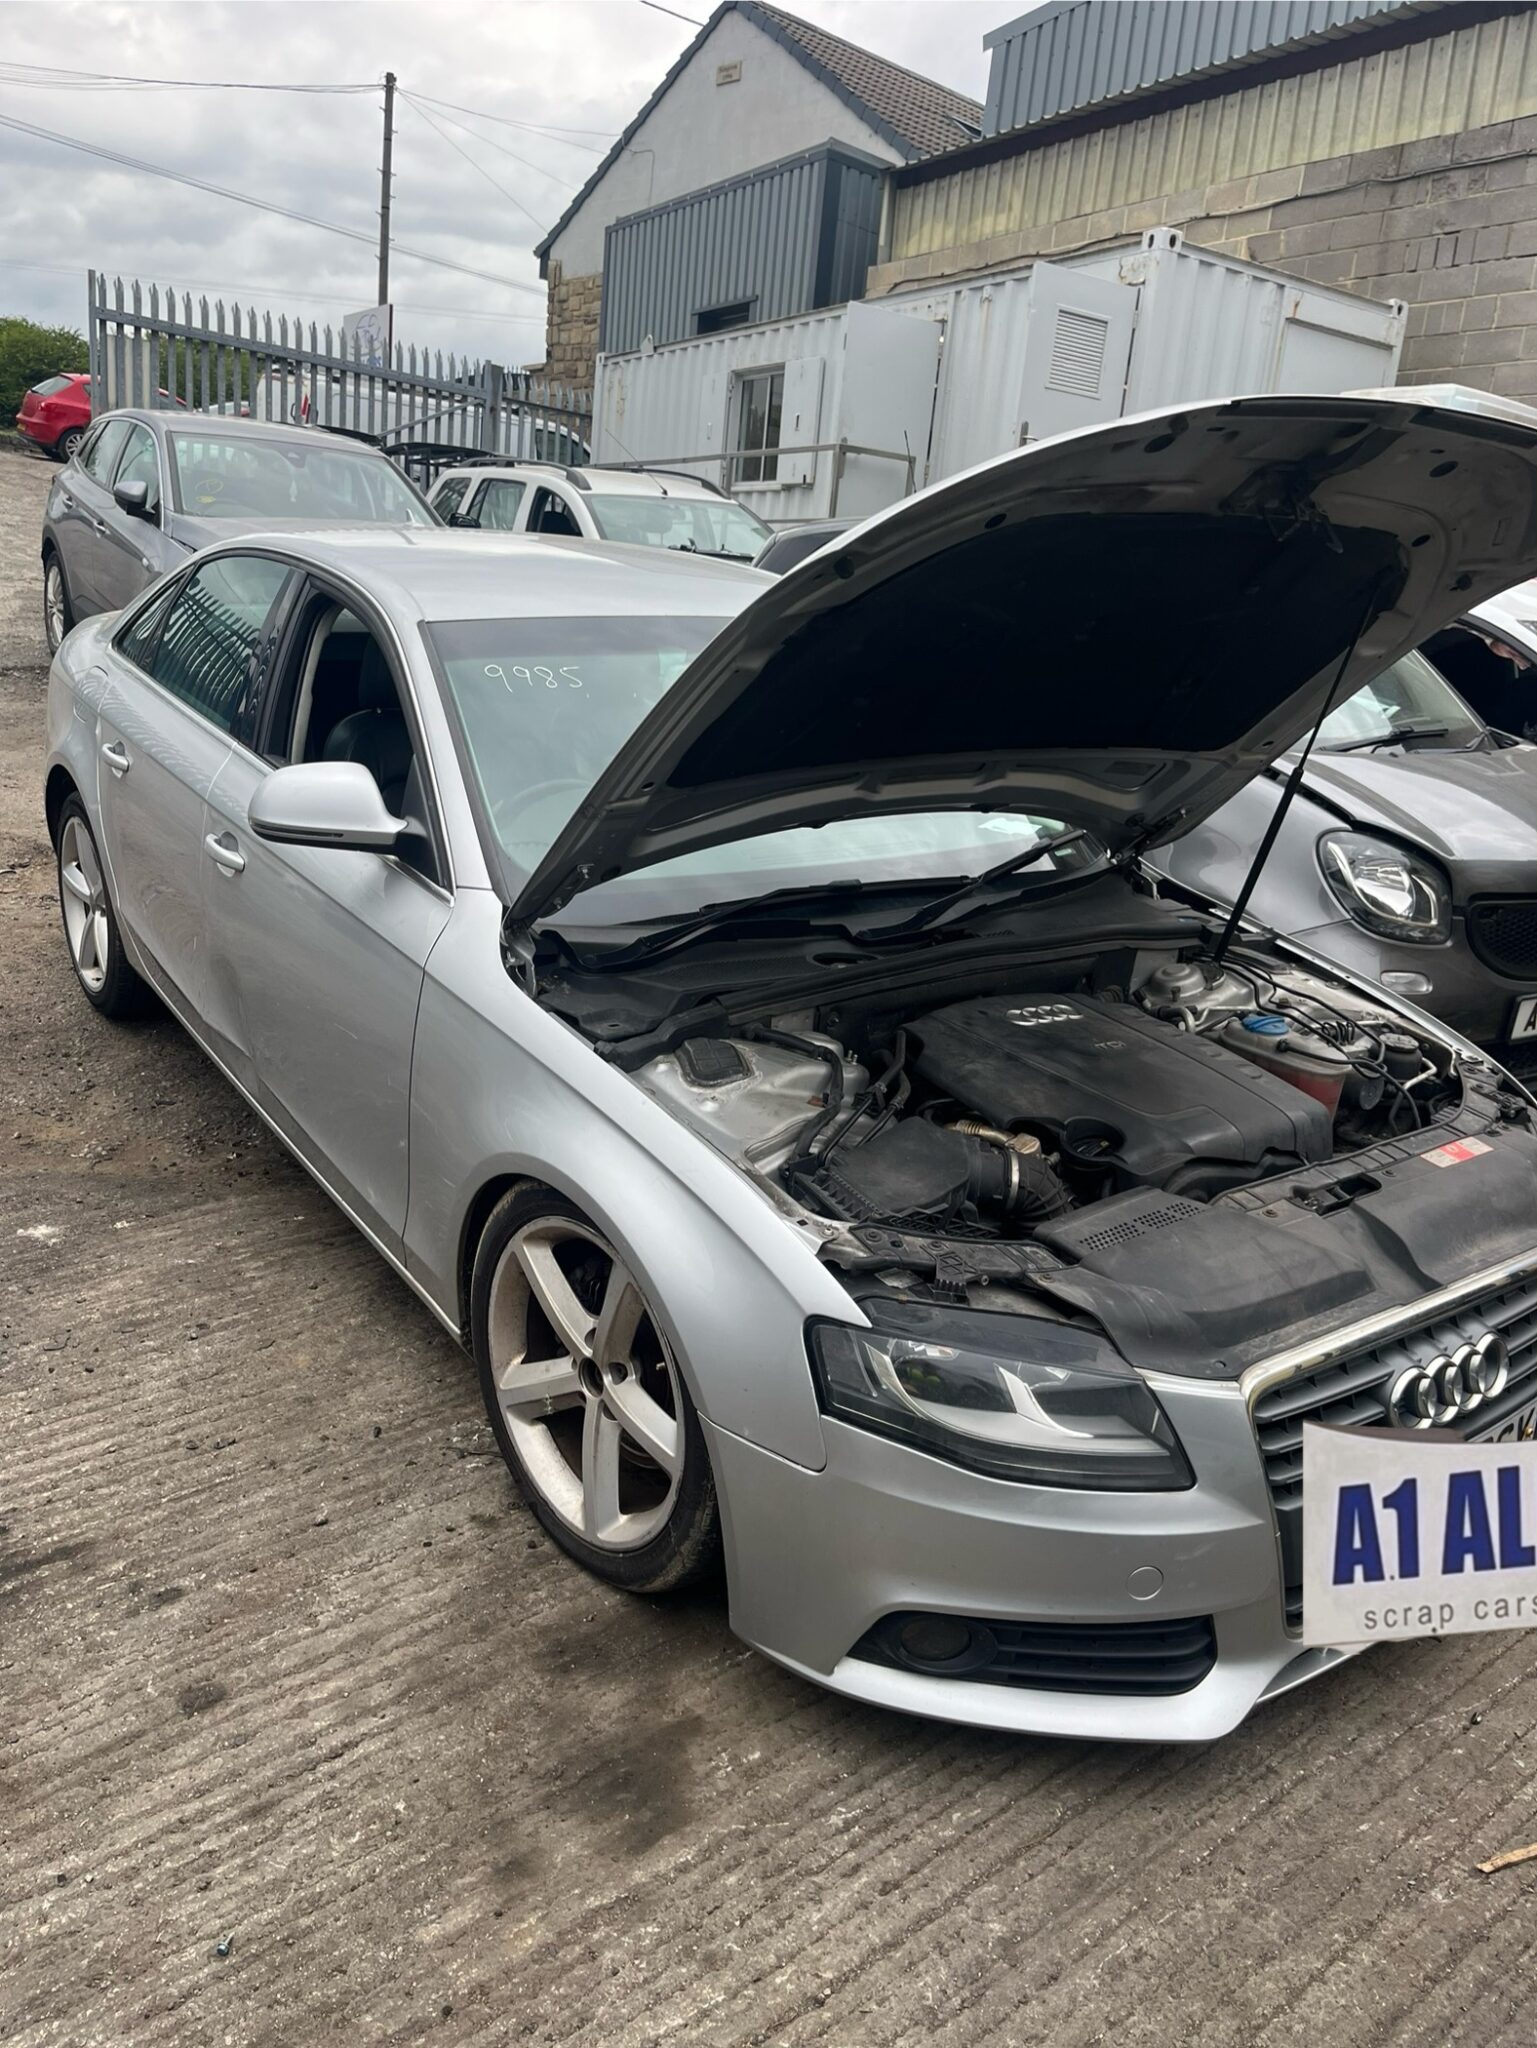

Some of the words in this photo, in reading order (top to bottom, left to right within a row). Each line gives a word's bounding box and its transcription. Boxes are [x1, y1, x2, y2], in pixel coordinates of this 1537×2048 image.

[484, 664, 583, 693] 9985
[1442, 1465, 1536, 1575] AL
[1364, 1602, 1455, 1629] scrap
